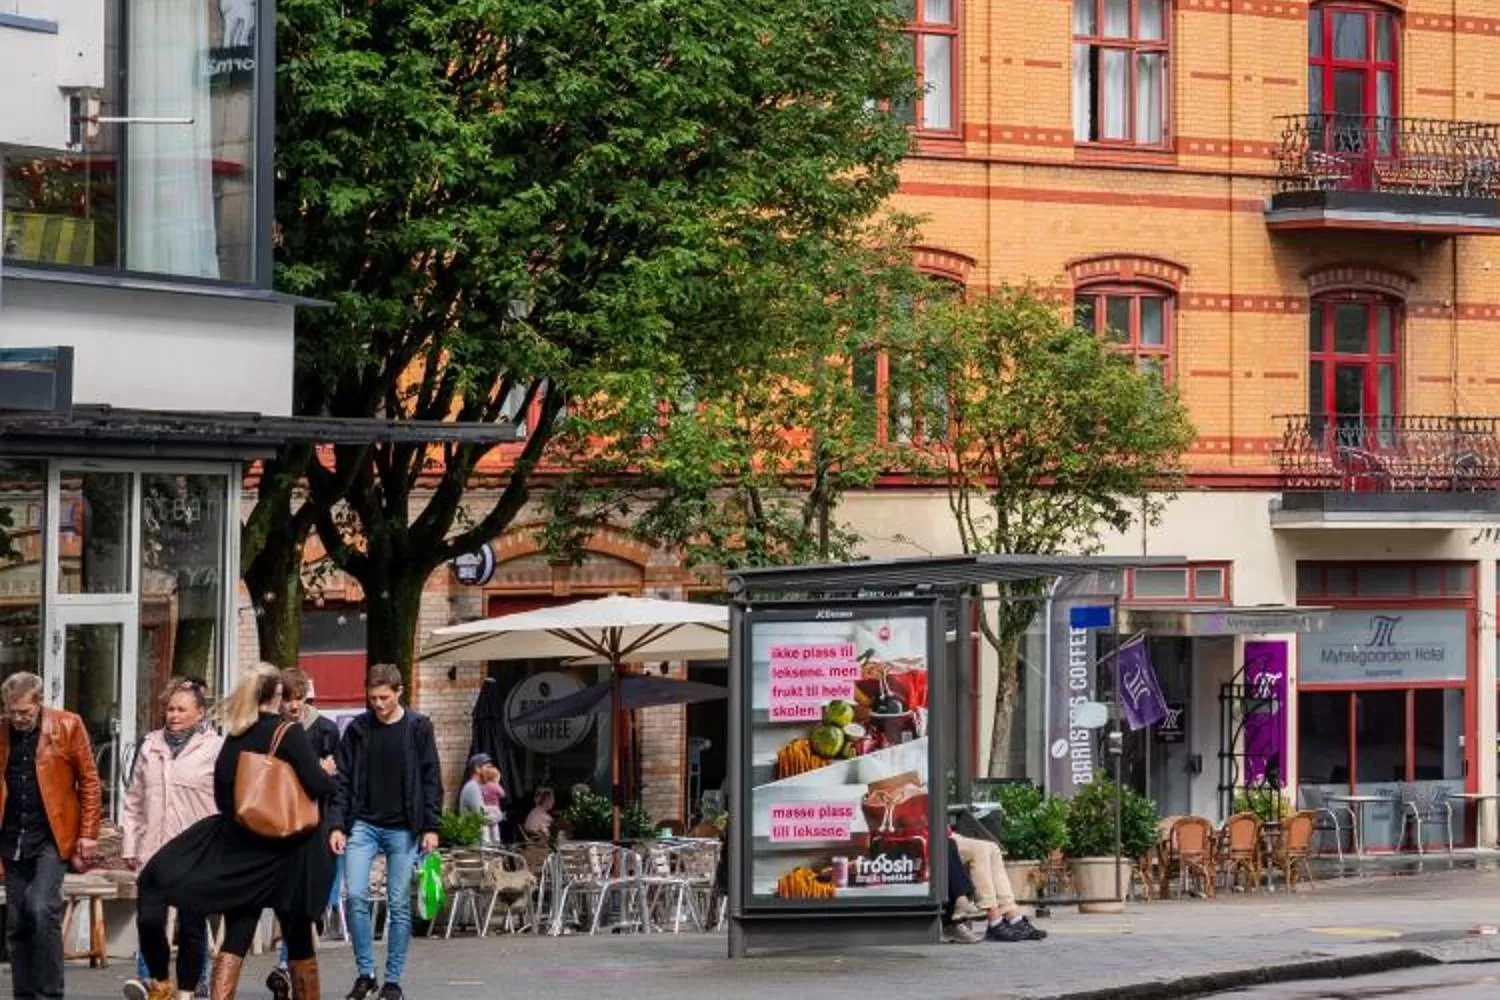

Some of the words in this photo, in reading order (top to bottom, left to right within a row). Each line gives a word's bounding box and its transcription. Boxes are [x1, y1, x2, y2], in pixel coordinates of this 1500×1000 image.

[802, 647, 837, 659] plass
[829, 666, 858, 677] men
[772, 684, 803, 697] frukt
[807, 683, 819, 696] til
[1069, 695, 1093, 785] BARISS
[772, 807, 815, 819] masse
[819, 805, 853, 819] plass
